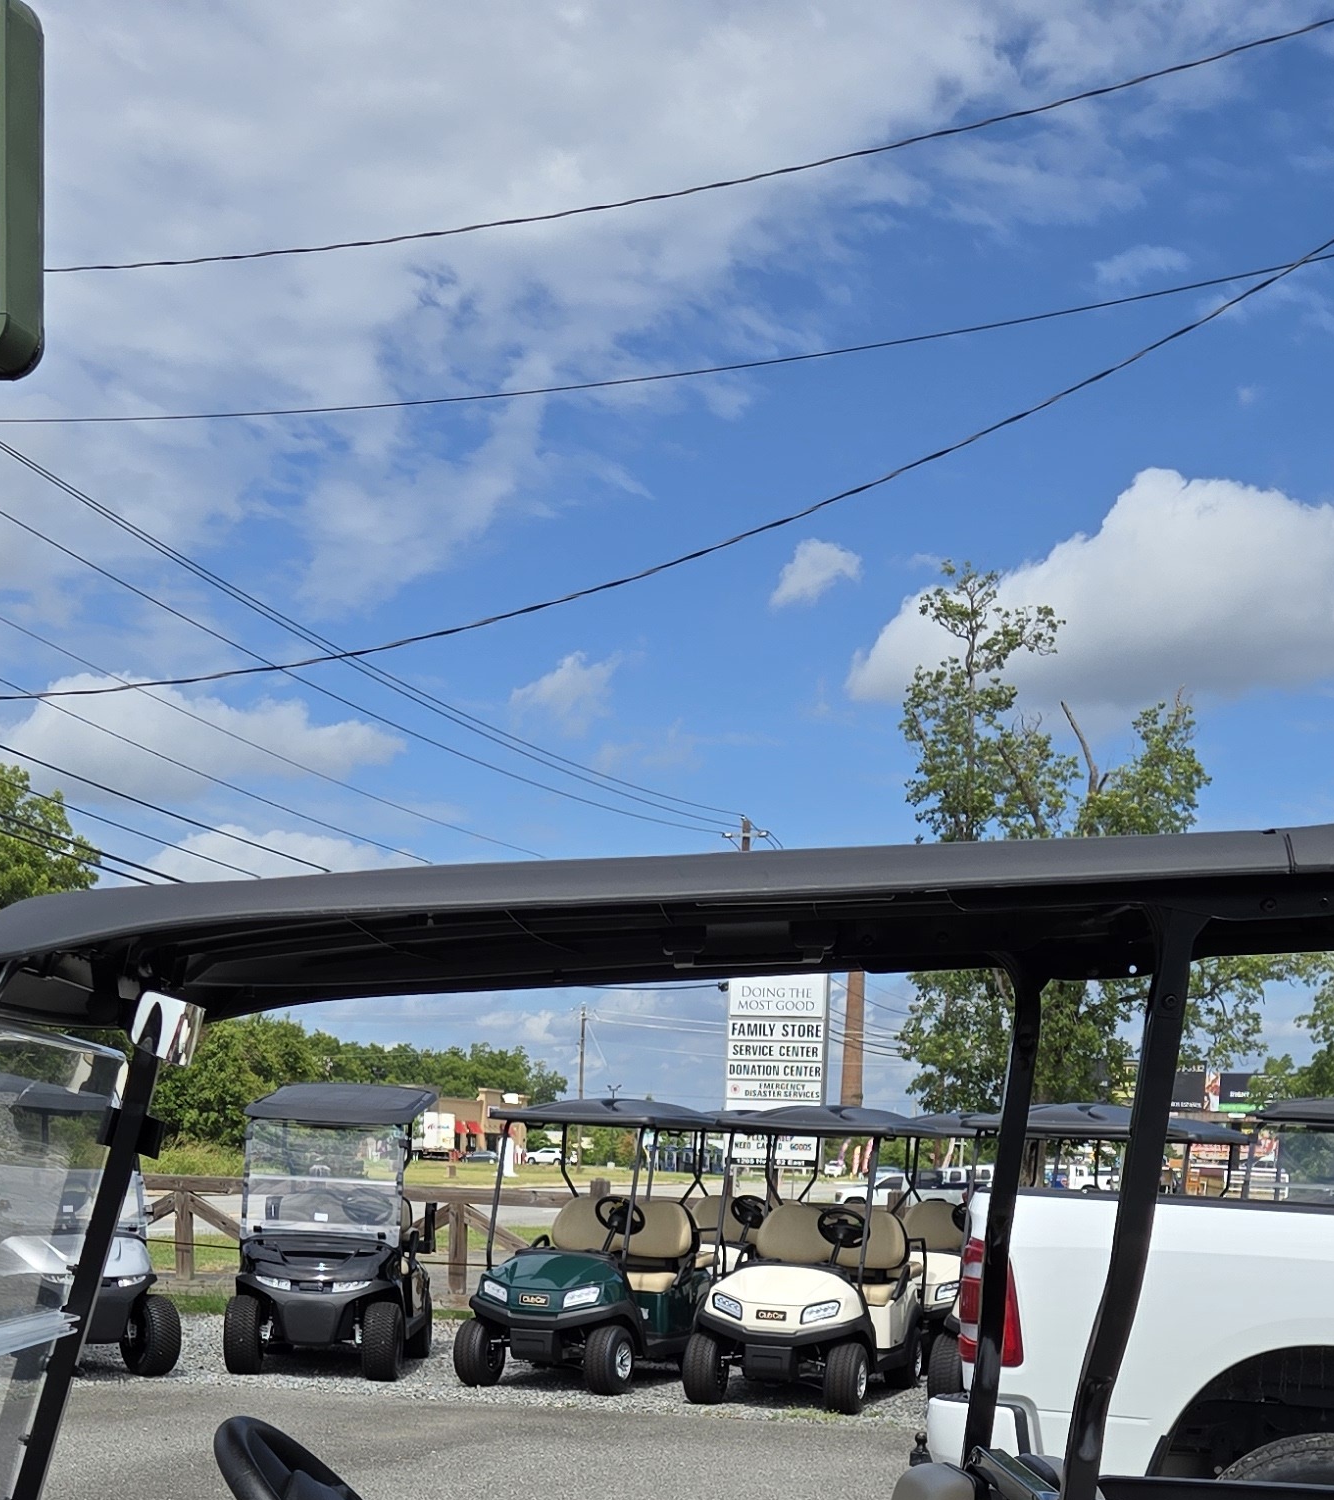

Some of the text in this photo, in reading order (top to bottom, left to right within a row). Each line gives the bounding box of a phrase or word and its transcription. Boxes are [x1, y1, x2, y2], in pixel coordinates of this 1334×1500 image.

[741, 985, 812, 998] DOING THE
[738, 1000, 815, 1011] MOST GOOD
[731, 1022, 822, 1038] FAMILY STORE
[732, 1044, 818, 1058] SERVICE CENTER
[729, 1064, 821, 1077] DONATION CENTER
[759, 1082, 806, 1090] EMERGENCY
